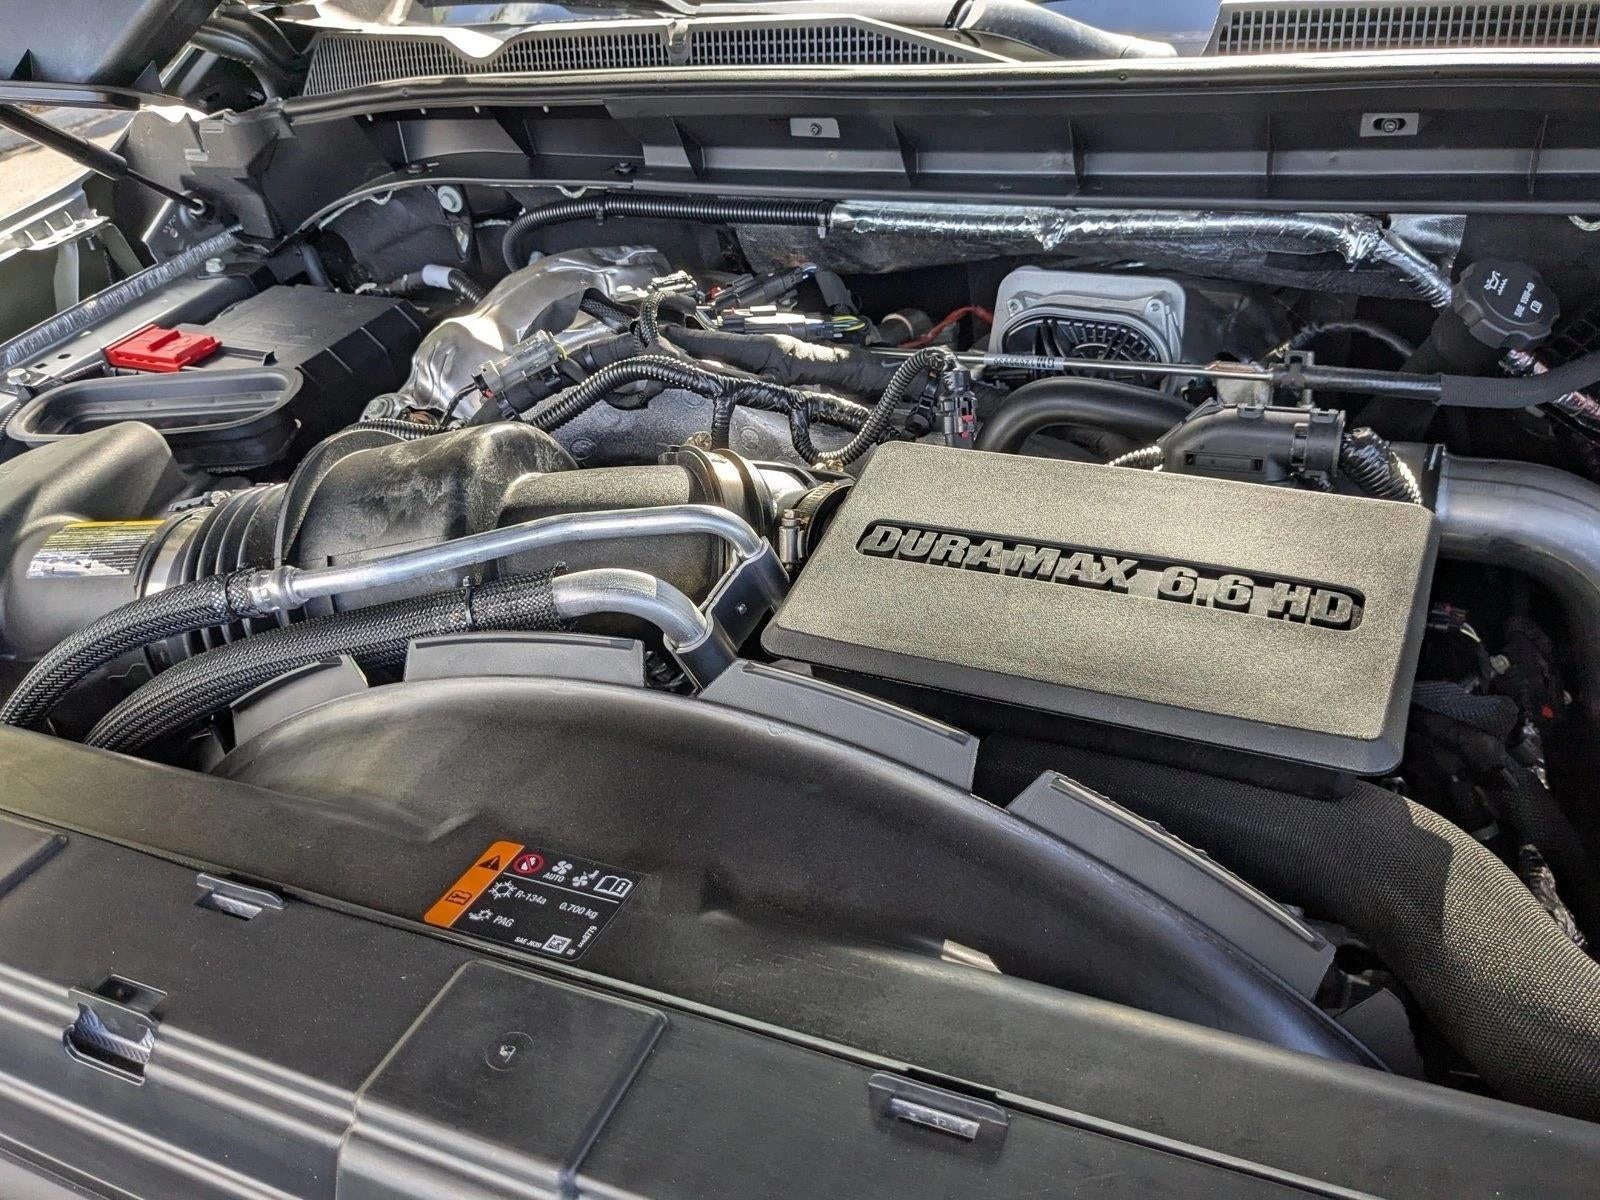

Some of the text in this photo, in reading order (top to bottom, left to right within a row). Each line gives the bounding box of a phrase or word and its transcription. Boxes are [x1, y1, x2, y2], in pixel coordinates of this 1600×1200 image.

[1037, 357, 1055, 369] GM
[861, 525, 1354, 626] DURAMAX 6.6 HD
[543, 872, 565, 883] AUTO
[515, 890, 599, 920] R-134a 0.700 kg
[493, 915, 515, 927] PAG
